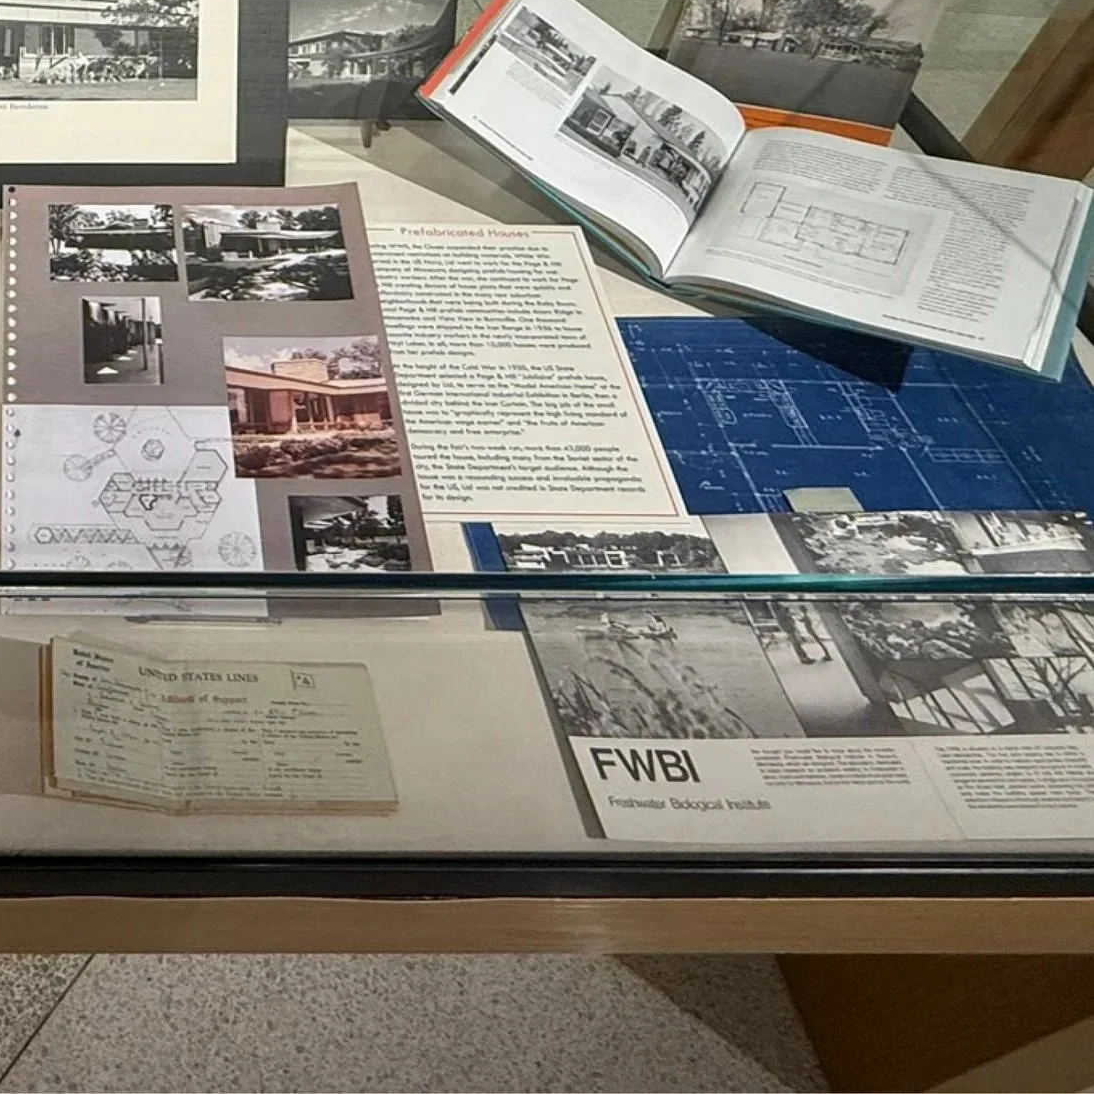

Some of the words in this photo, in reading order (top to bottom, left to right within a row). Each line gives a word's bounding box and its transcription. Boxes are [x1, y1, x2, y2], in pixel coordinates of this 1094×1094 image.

[400, 227, 484, 237] Prefabricated
[487, 228, 529, 238] Houses
[181, 672, 222, 682] STATES
[226, 672, 259, 683] LINES
[589, 748, 700, 782] FWBI
[607, 796, 666, 809] Freshwater
[669, 797, 724, 811] Biological
[725, 799, 771, 810] Institute
